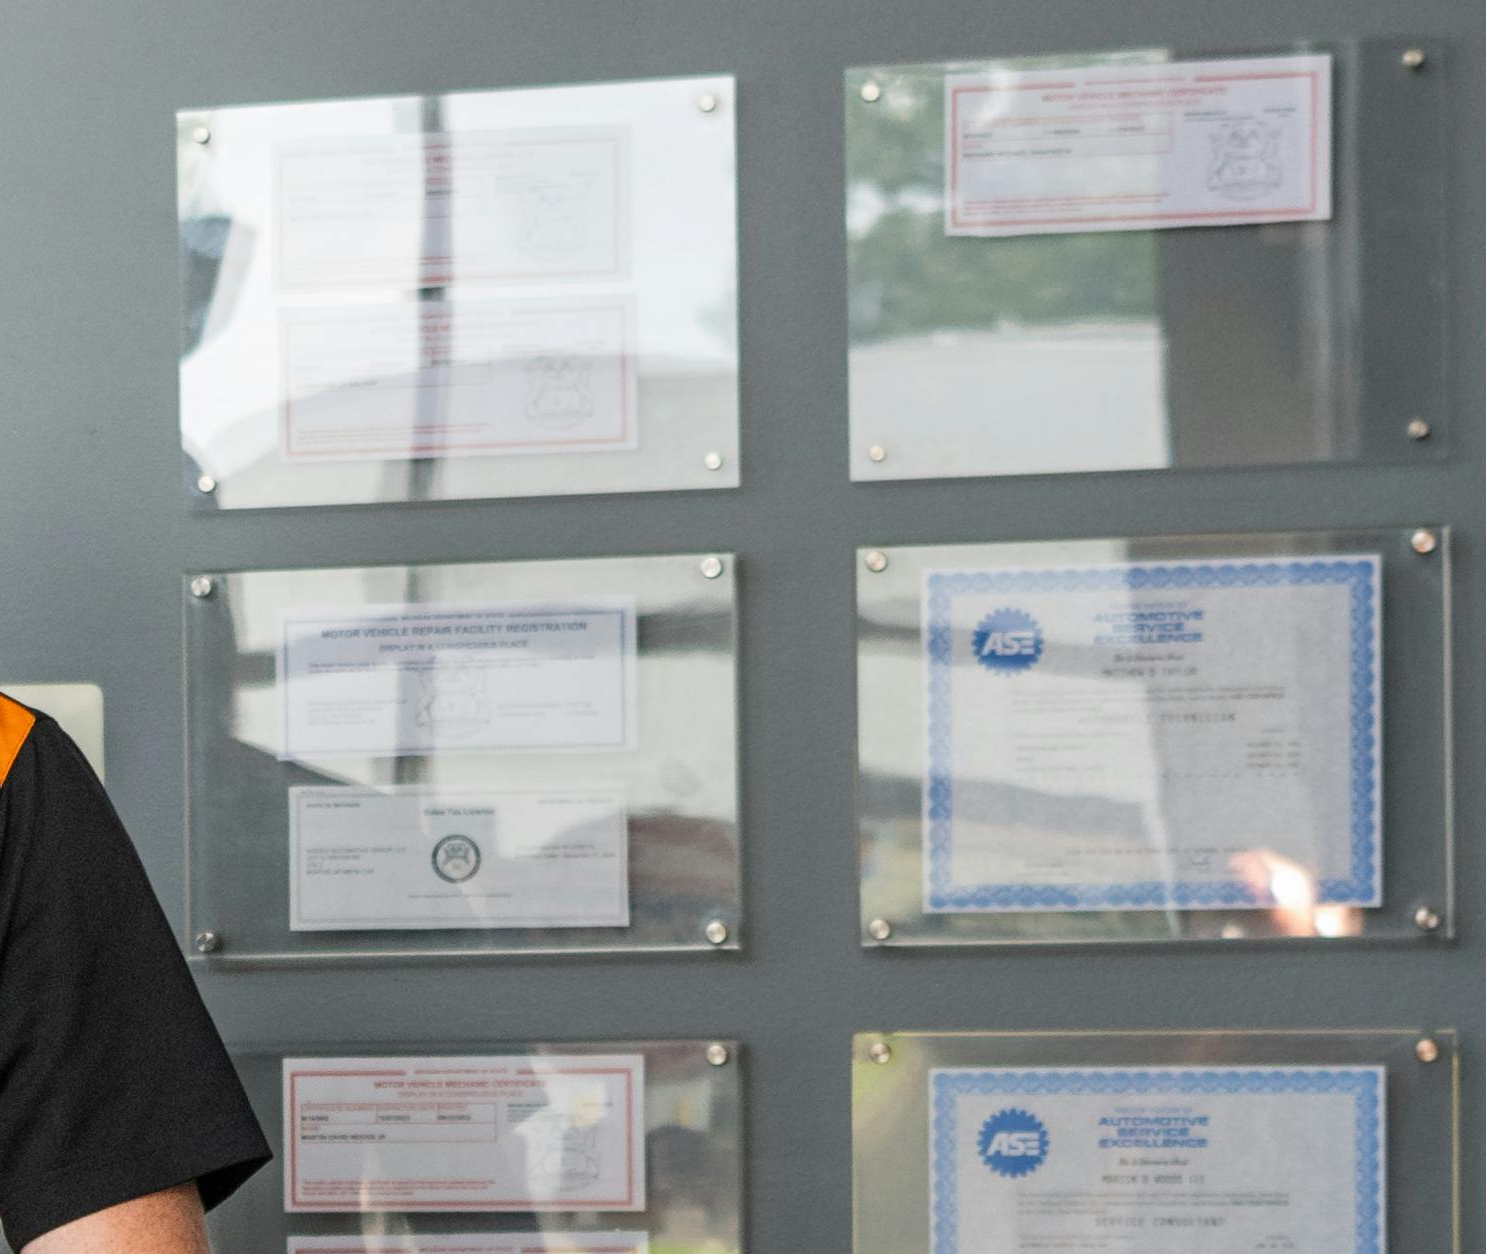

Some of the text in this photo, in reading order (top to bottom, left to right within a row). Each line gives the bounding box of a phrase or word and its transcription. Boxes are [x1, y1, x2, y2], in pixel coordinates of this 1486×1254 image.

[1093, 610, 1205, 623] AUTOMOTIVE
[321, 621, 588, 640] MOTOR VEHICLE REPAIR FACILITY REGISTRATION
[1112, 622, 1186, 633] SERVICE
[981, 631, 1036, 655] ASE
[1093, 633, 1204, 646] EXCELLENCE
[1097, 1116, 1209, 1127] AUTOMOTIVE
[1116, 1127, 1190, 1138] SERVICE
[985, 1132, 1040, 1157] ASE
[1098, 1138, 1208, 1149] EXCELLENCE
